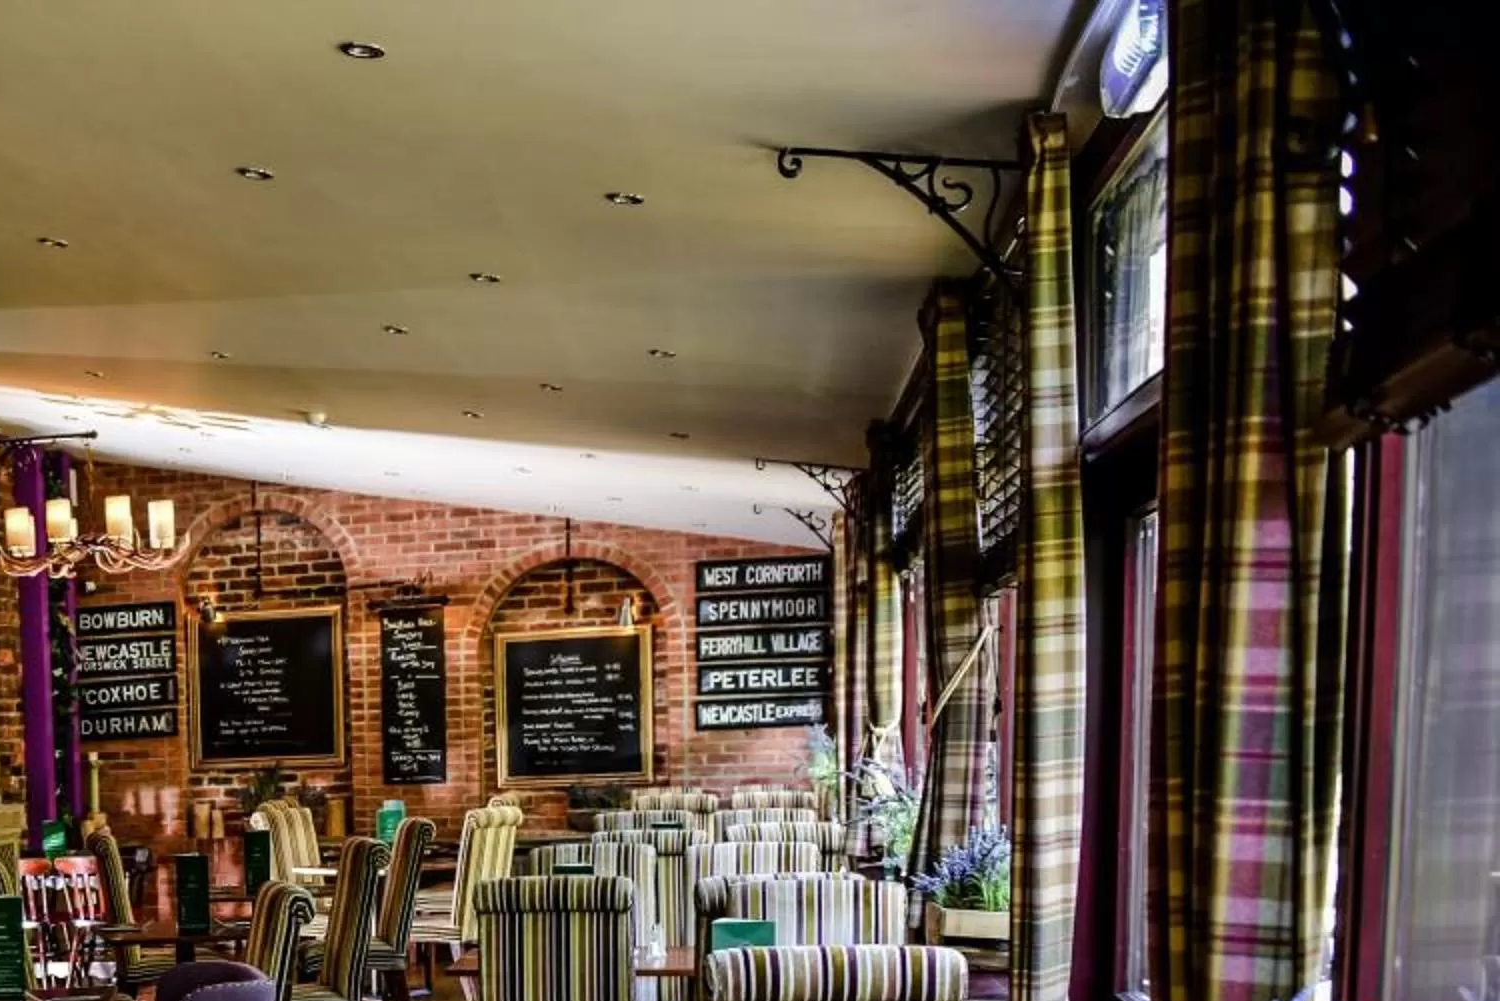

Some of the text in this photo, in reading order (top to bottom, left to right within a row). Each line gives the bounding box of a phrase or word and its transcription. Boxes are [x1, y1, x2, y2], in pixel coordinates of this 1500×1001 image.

[703, 562, 823, 587] WEST CORNFORTH
[80, 608, 164, 629] BOWBURN
[708, 597, 816, 621] SPENNYMOOR
[76, 640, 172, 661] NEWCASTLE
[700, 631, 822, 659] FERRYHILL VILLAGE
[709, 667, 819, 689] PETERLEE
[86, 683, 161, 705] COXHOE
[81, 714, 166, 735] DURHAM
[699, 703, 775, 725] NEWCASTLE
